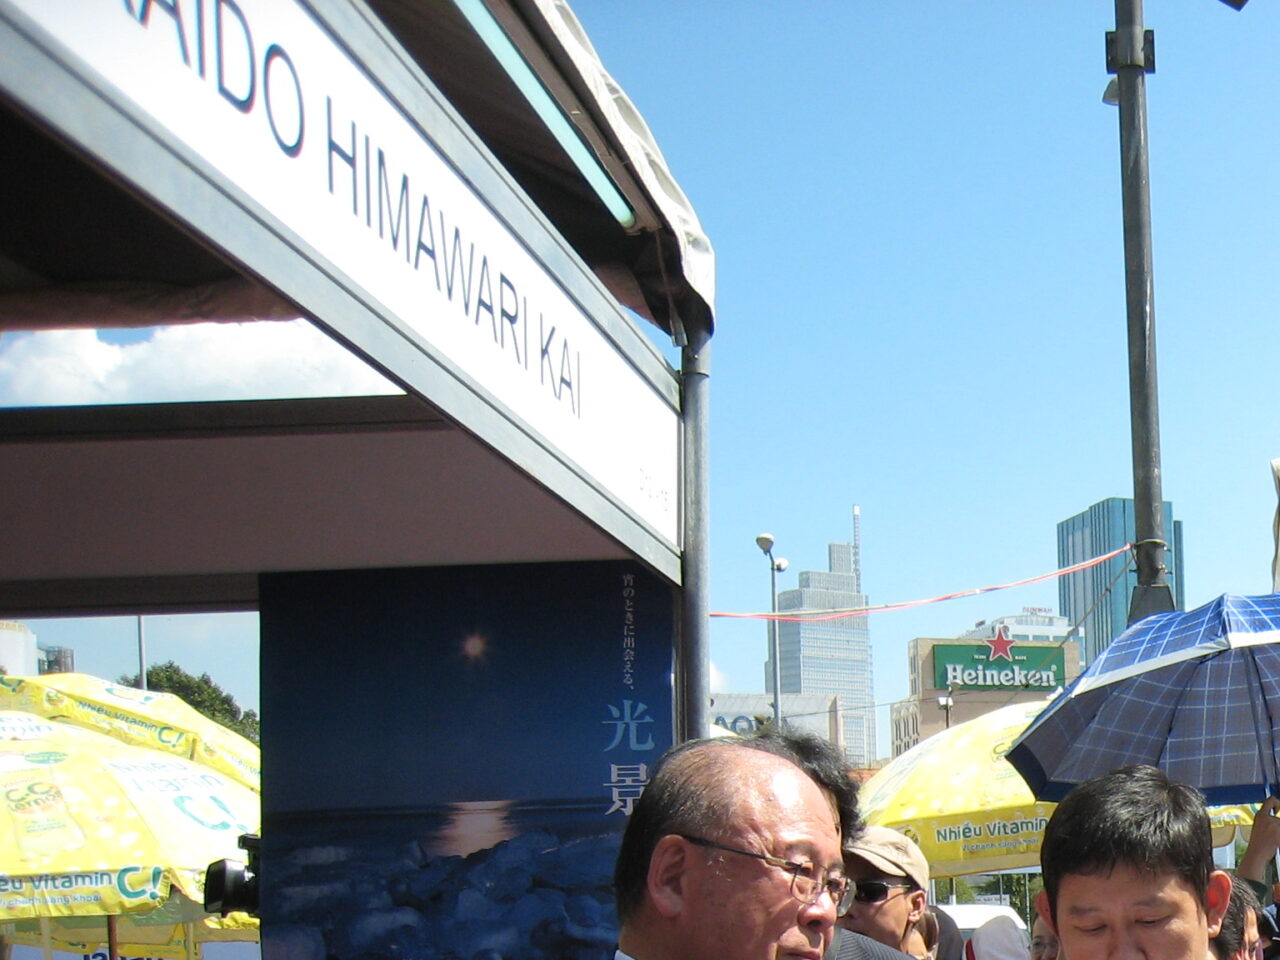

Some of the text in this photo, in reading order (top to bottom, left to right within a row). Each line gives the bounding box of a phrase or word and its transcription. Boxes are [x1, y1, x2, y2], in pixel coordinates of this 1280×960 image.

[326, 94, 528, 371] HIMAWARI
[539, 311, 581, 420] KAI
[945, 663, 1057, 686] Heineken
[602, 699, 656, 817] 光景
[986, 817, 1049, 837] Vitamin
[28, 871, 112, 890] Vitamin
[116, 865, 163, 900] C!
